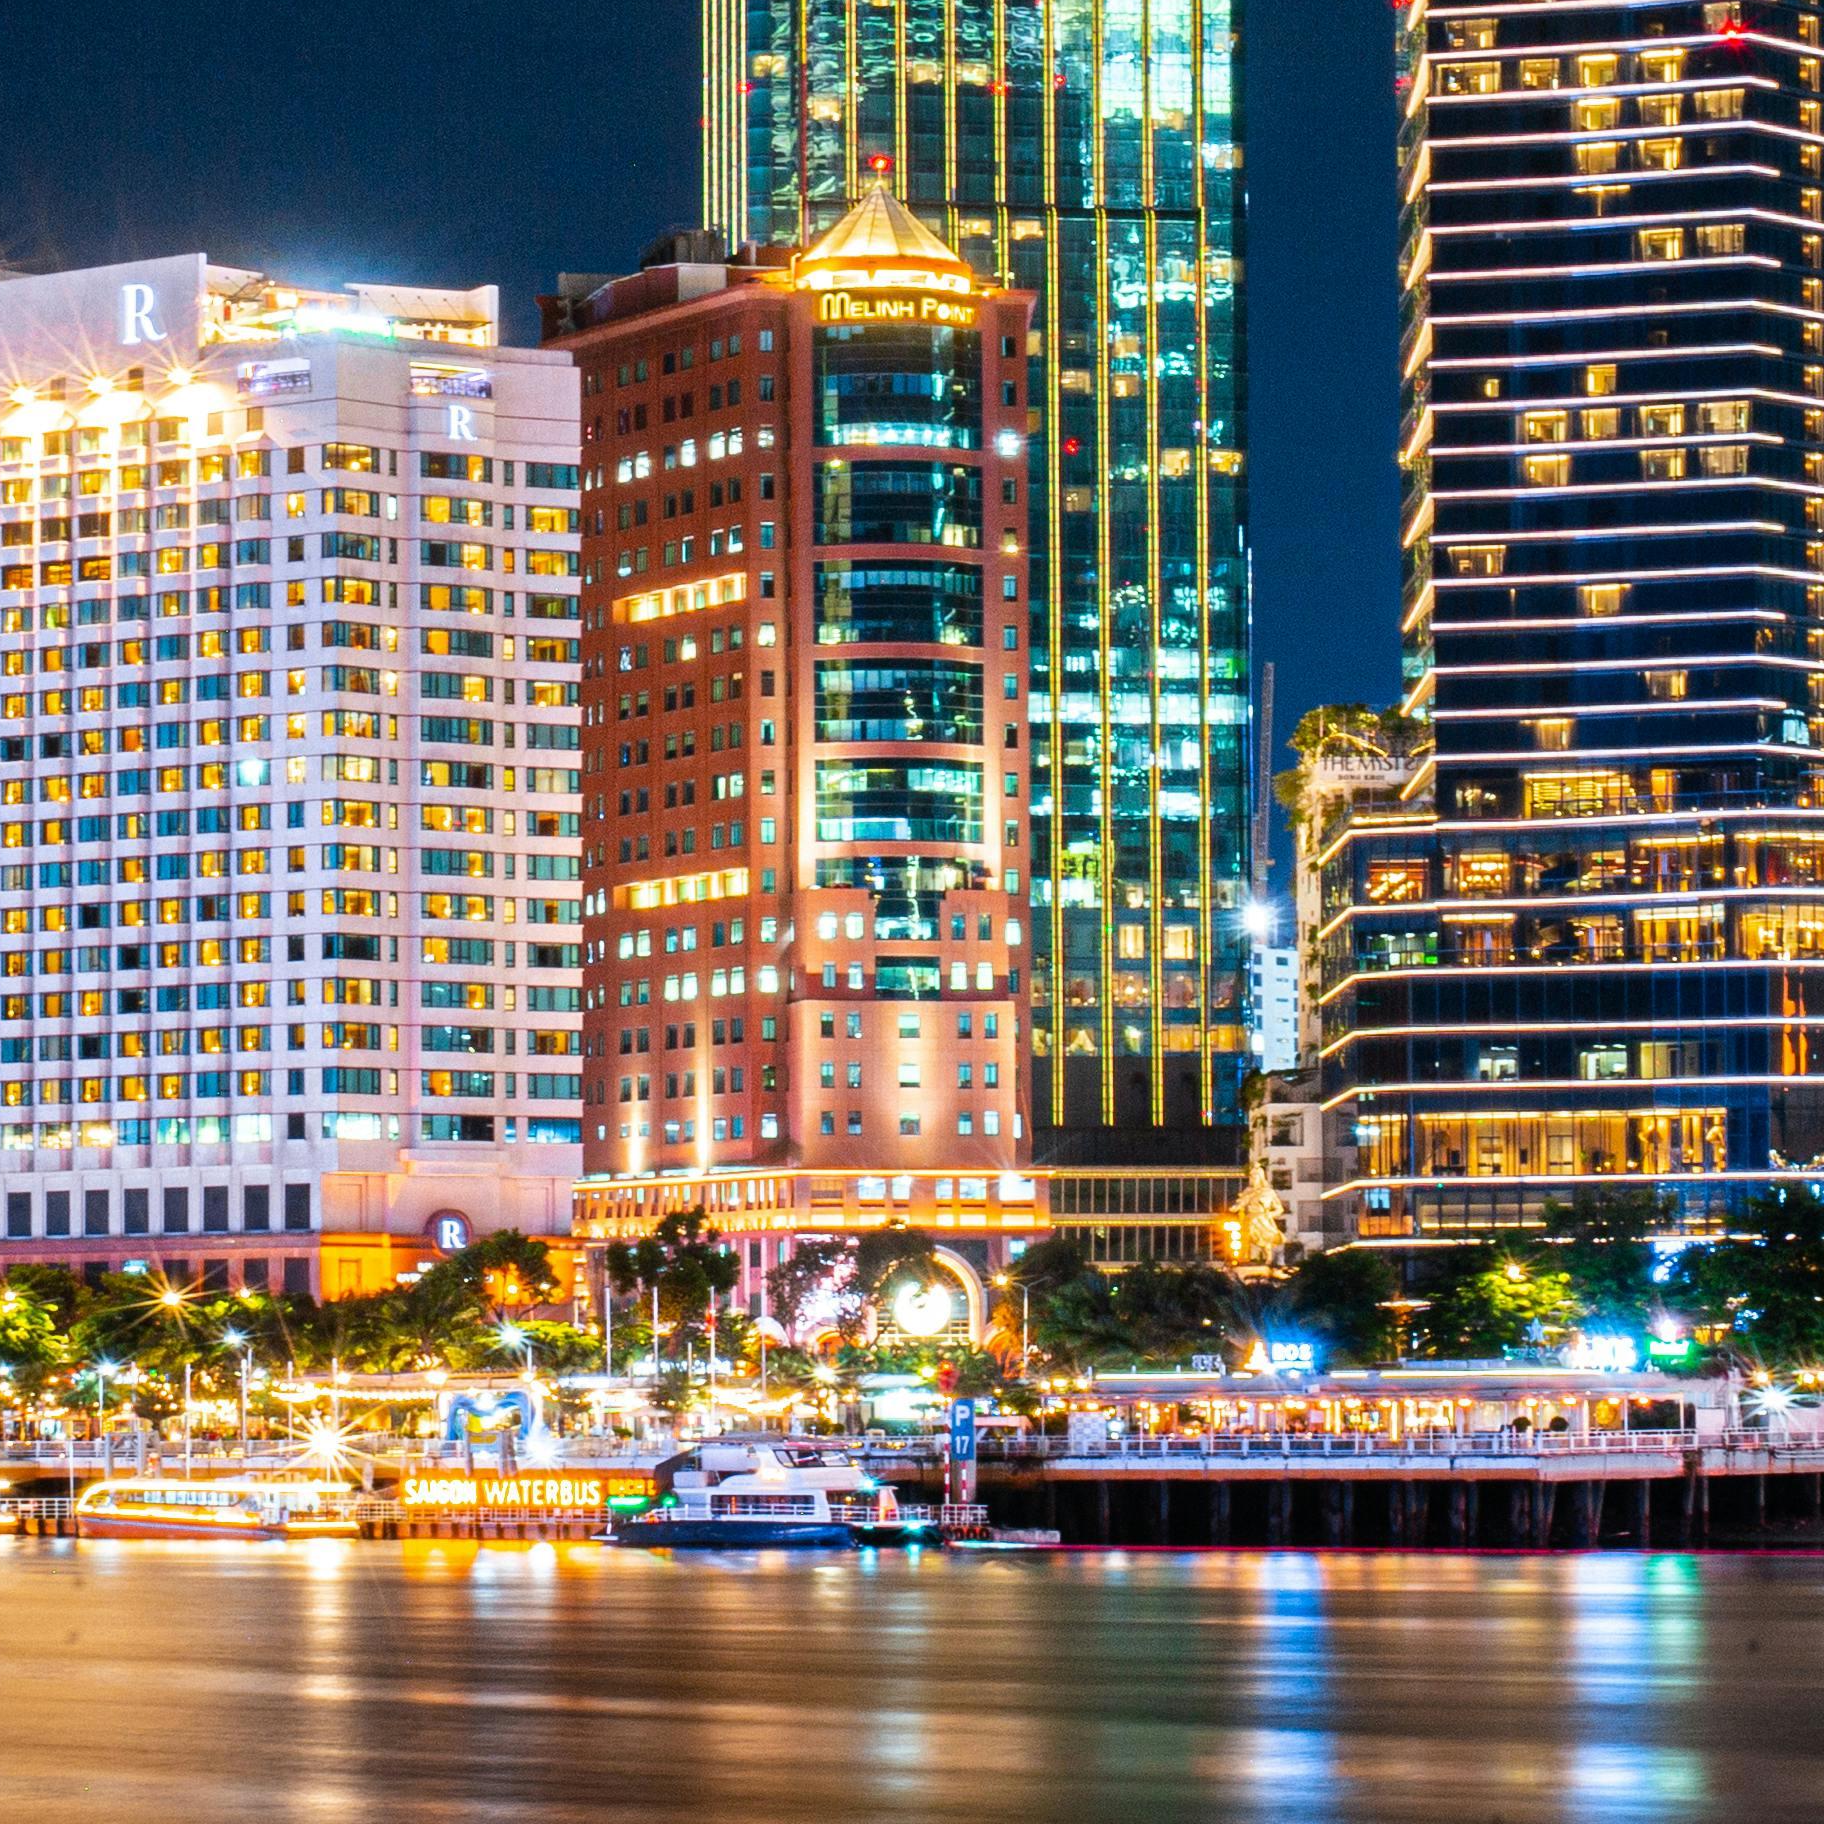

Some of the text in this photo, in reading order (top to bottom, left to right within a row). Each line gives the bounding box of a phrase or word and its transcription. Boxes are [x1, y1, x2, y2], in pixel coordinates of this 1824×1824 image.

[122, 284, 168, 345] R
[448, 404, 478, 441] R
[1320, 753, 1355, 771] THE
[441, 1220, 466, 1248] R
[955, 1405, 970, 1426] P
[955, 1435, 970, 1454] 17
[404, 1478, 601, 1506] SAIGON WATERBUS
